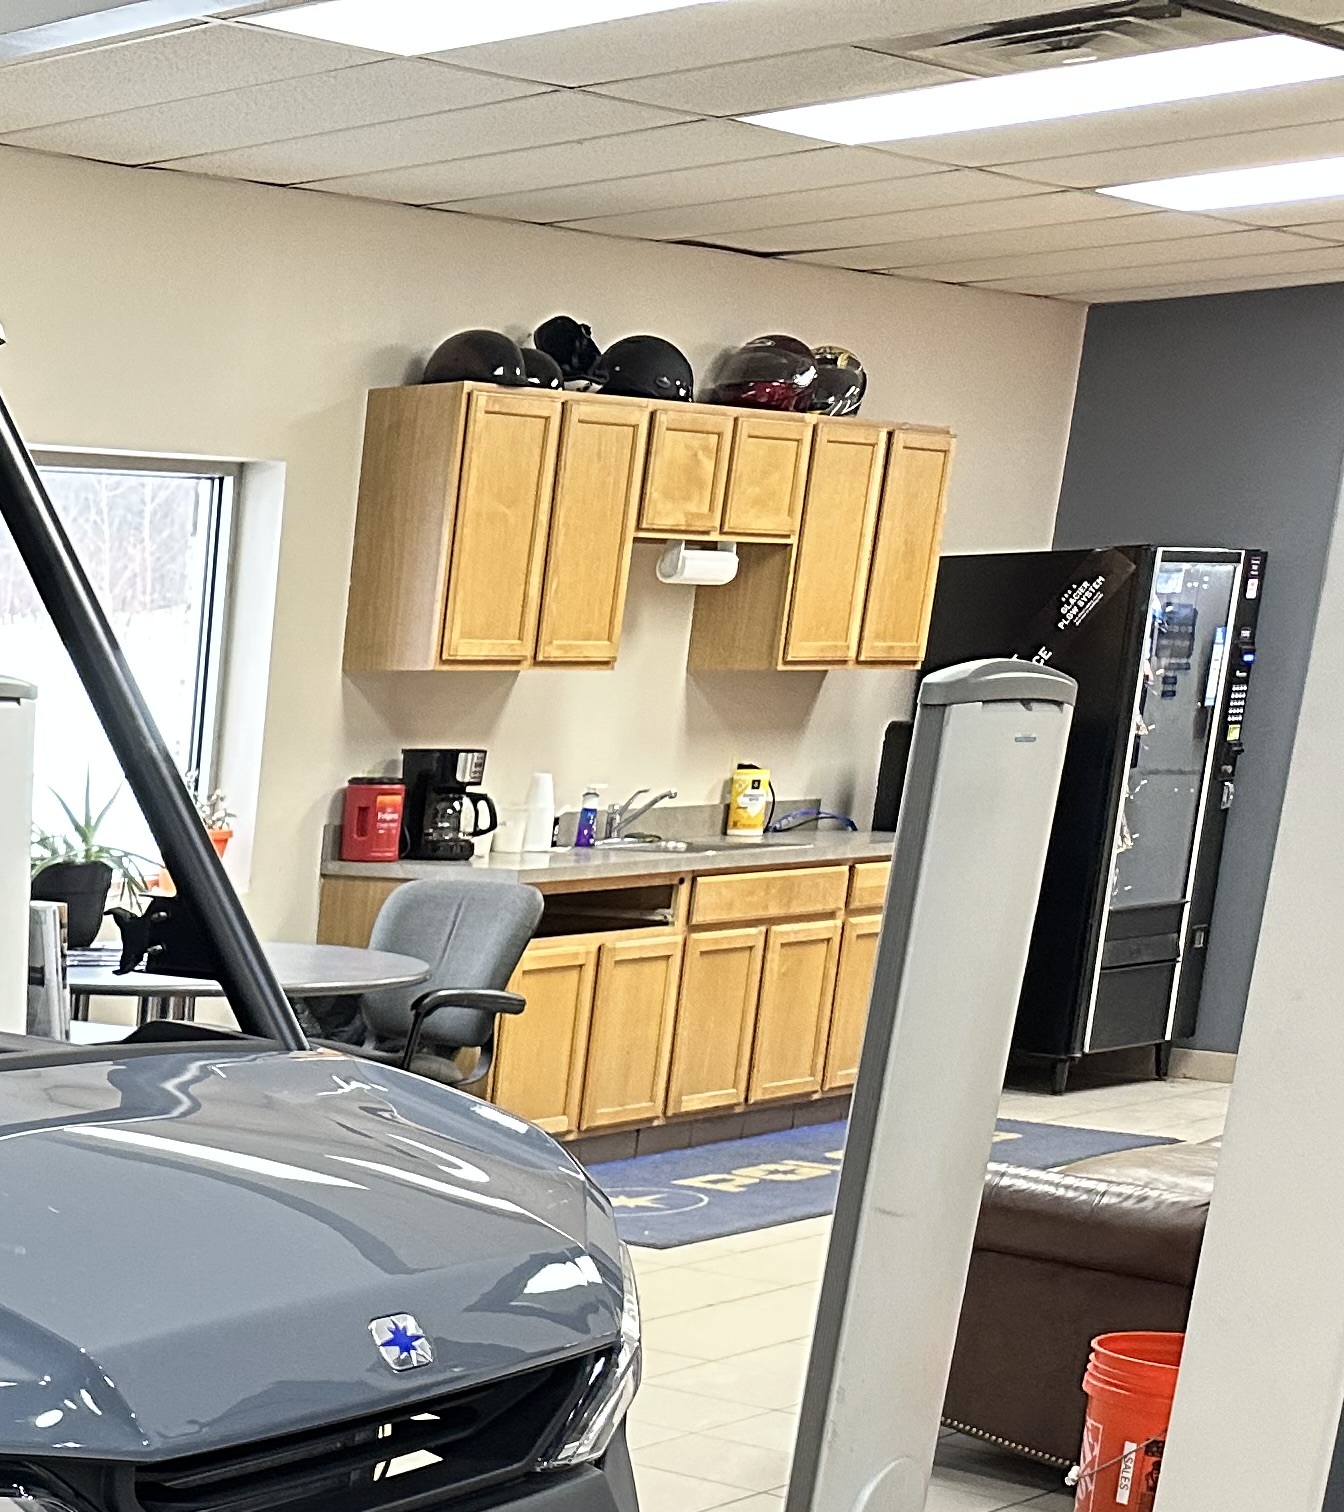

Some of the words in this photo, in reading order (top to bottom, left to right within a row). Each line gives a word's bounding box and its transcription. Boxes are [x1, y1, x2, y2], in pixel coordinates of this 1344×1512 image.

[1057, 605, 1079, 630] PLOW
[1077, 575, 1106, 607] SYSTEM
[1061, 580, 1090, 614] GLACIER
[1119, 1456, 1134, 1491] SALES
